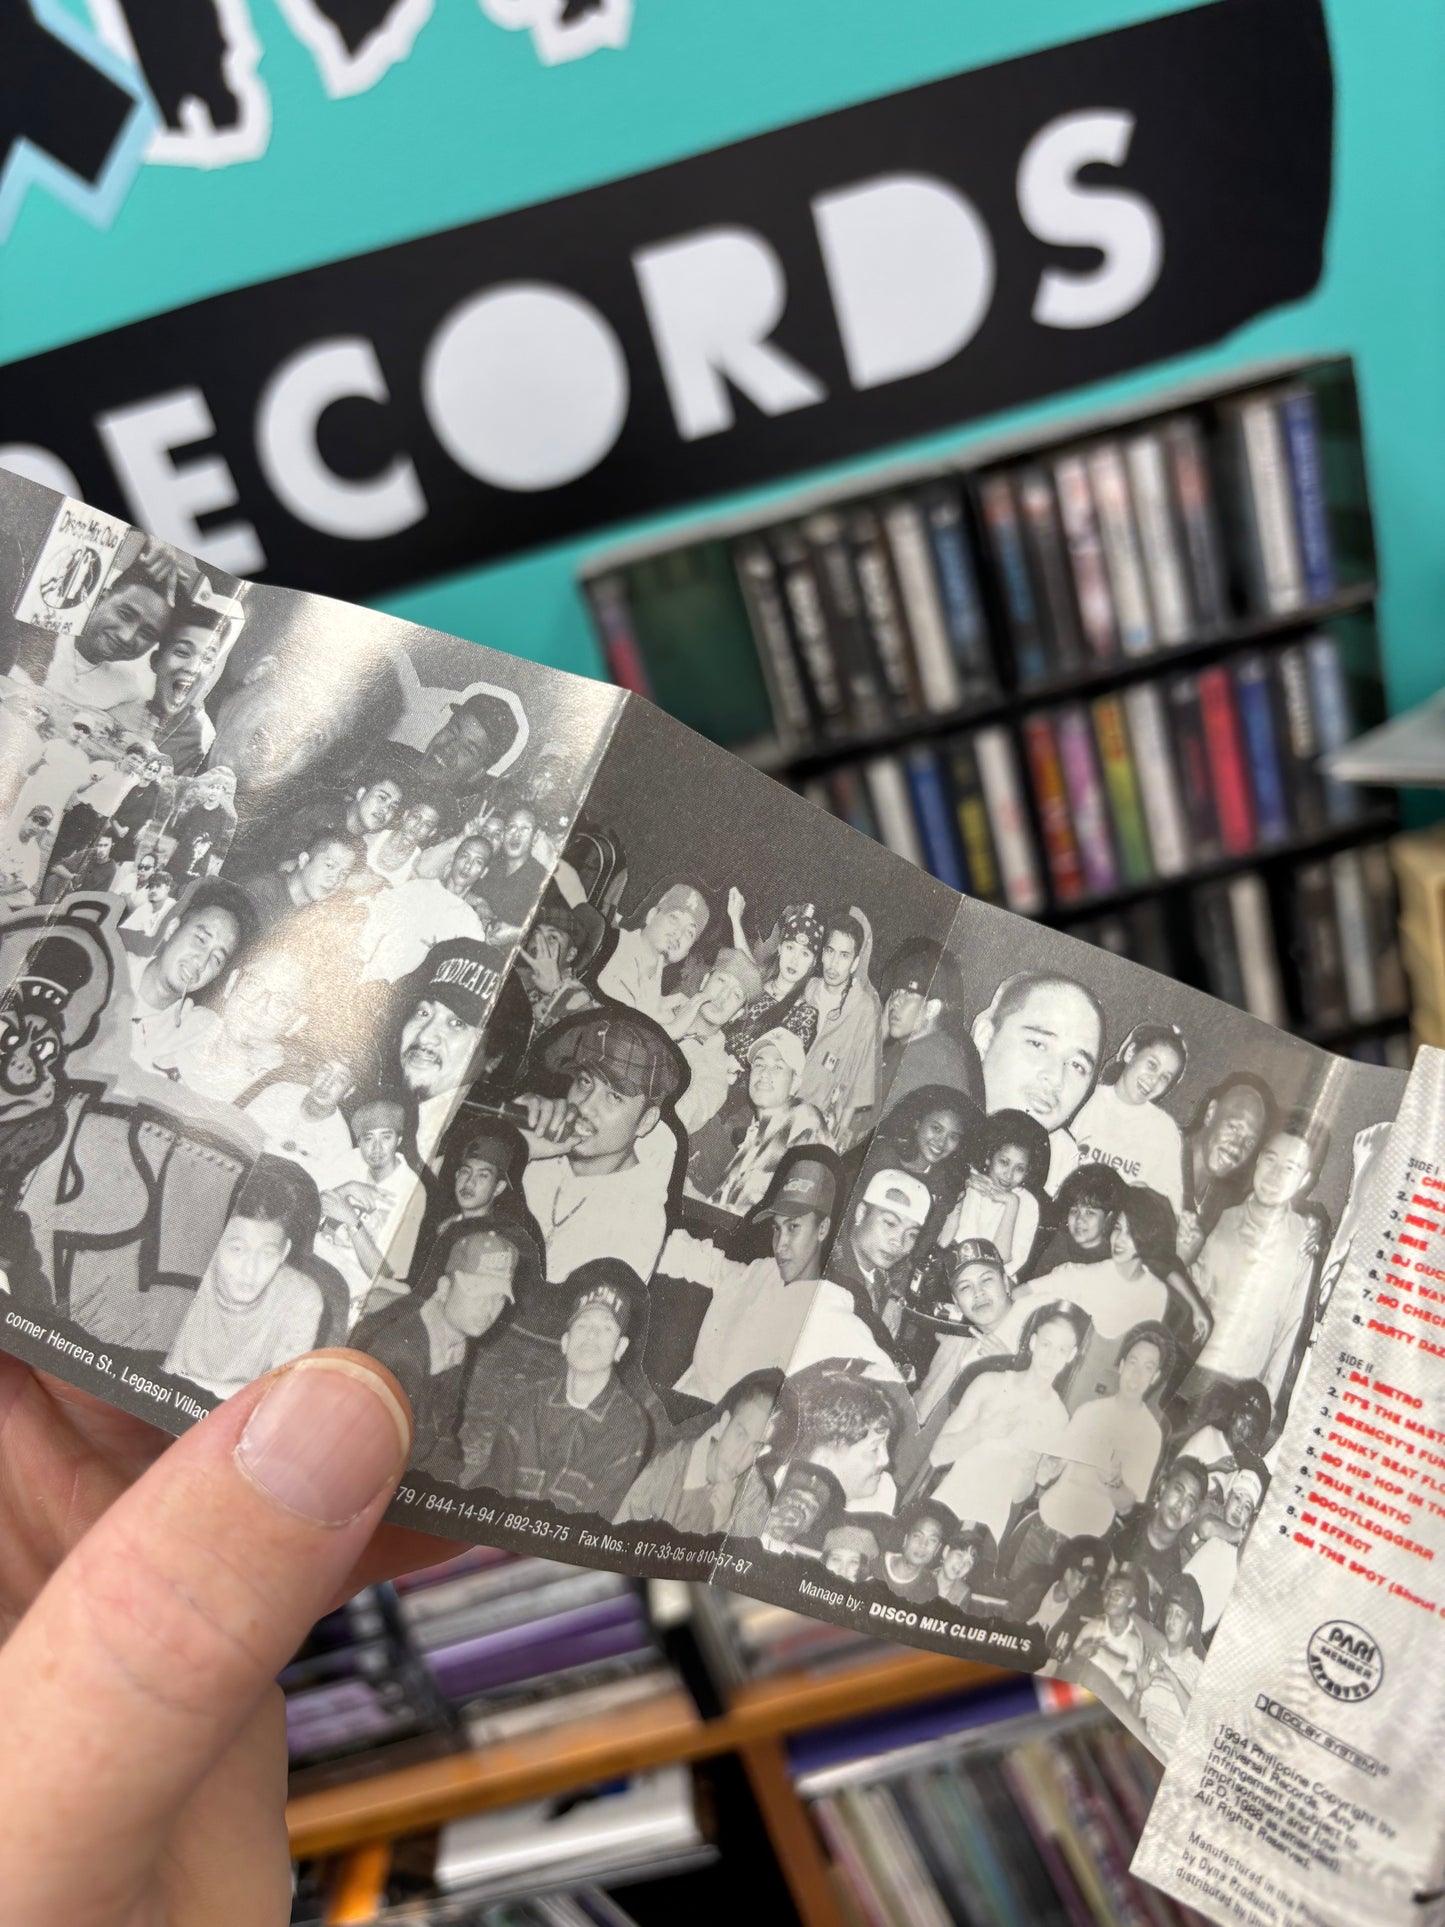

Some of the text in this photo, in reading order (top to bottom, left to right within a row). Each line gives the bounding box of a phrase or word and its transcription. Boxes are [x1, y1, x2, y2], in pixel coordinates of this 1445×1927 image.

[1405, 1172, 1415, 1183] 1.
[1408, 1157, 1433, 1173] SIDE
[1390, 1210, 1401, 1221] 3.
[1397, 1191, 1408, 1202] 2.
[1376, 1249, 1387, 1261] 5.
[1383, 1230, 1395, 1241] 4.
[1363, 1289, 1374, 1301] 7.
[1369, 1269, 1380, 1281] 6.
[1385, 1273, 1414, 1292] THE
[1353, 1314, 1365, 1326] 8.
[1367, 1319, 1415, 1344] PARTY
[6, 1311, 47, 1340] corner
[49, 1329, 95, 1365] Herrera
[96, 1354, 117, 1380] St.,
[120, 1366, 173, 1404] Legaspi
[1338, 1352, 1364, 1370] SIDE
[1328, 1386, 1339, 1398] 2.
[1342, 1391, 1370, 1410] IT'S
[1374, 1404, 1402, 1424] THE
[1336, 1366, 1346, 1379] 1.
[1372, 1380, 1423, 1409] METRO
[1320, 1406, 1331, 1418] 3.
[1313, 1427, 1324, 1438] 4.
[1328, 1432, 1378, 1460] FUNKY
[1381, 1456, 1418, 1479] BEAT
[1294, 1484, 1305, 1498] 7.
[1306, 1446, 1317, 1458] 5.
[1321, 1451, 1343, 1468] NO
[1346, 1463, 1371, 1480] HIP
[1374, 1476, 1404, 1496] HOP
[1407, 1492, 1424, 1507] IN
[425, 1494, 496, 1526] 844-14-94
[504, 1513, 570, 1541] 892-33-75
[1315, 1471, 1354, 1497] TRUE
[1356, 1491, 1412, 1525] ASIATIC
[1286, 1505, 1373, 1555] 8. IN EFFECT
[578, 1530, 752, 1574] Fax Nos.: 817-33-05 or 810-57-87
[1279, 1525, 1290, 1538] 9.
[1293, 1532, 1315, 1549] ON
[1319, 1543, 1346, 1565] THE
[1349, 1561, 1387, 1586] SPOT
[799, 1579, 1032, 1652] Manage by: DISCO MIX CLUB PHIL'S
[1320, 1645, 1372, 1680] MEMBER
[1328, 1627, 1377, 1662] PARI
[1213, 1736, 1267, 1776] Universal
[1282, 1712, 1376, 1770] DOLBY SYSTEM
[1208, 1749, 1283, 1802] infringement
[1219, 1724, 1249, 1749] 1994
[1250, 1743, 1310, 1787] Philippine
[1312, 1782, 1376, 1826] Copyright
[1194, 1791, 1213, 1807] All
[1216, 1801, 1254, 1832] Rights
[1203, 1764, 1285, 1820] imprisonment
[1286, 1815, 1310, 1836] and
[1265, 1818, 1278, 1832] as
[1182, 1849, 1196, 1866] by
[1188, 1831, 1263, 1886] Manufactured
[1264, 1878, 1275, 1895] in
[1176, 1866, 1232, 1908] distributed
